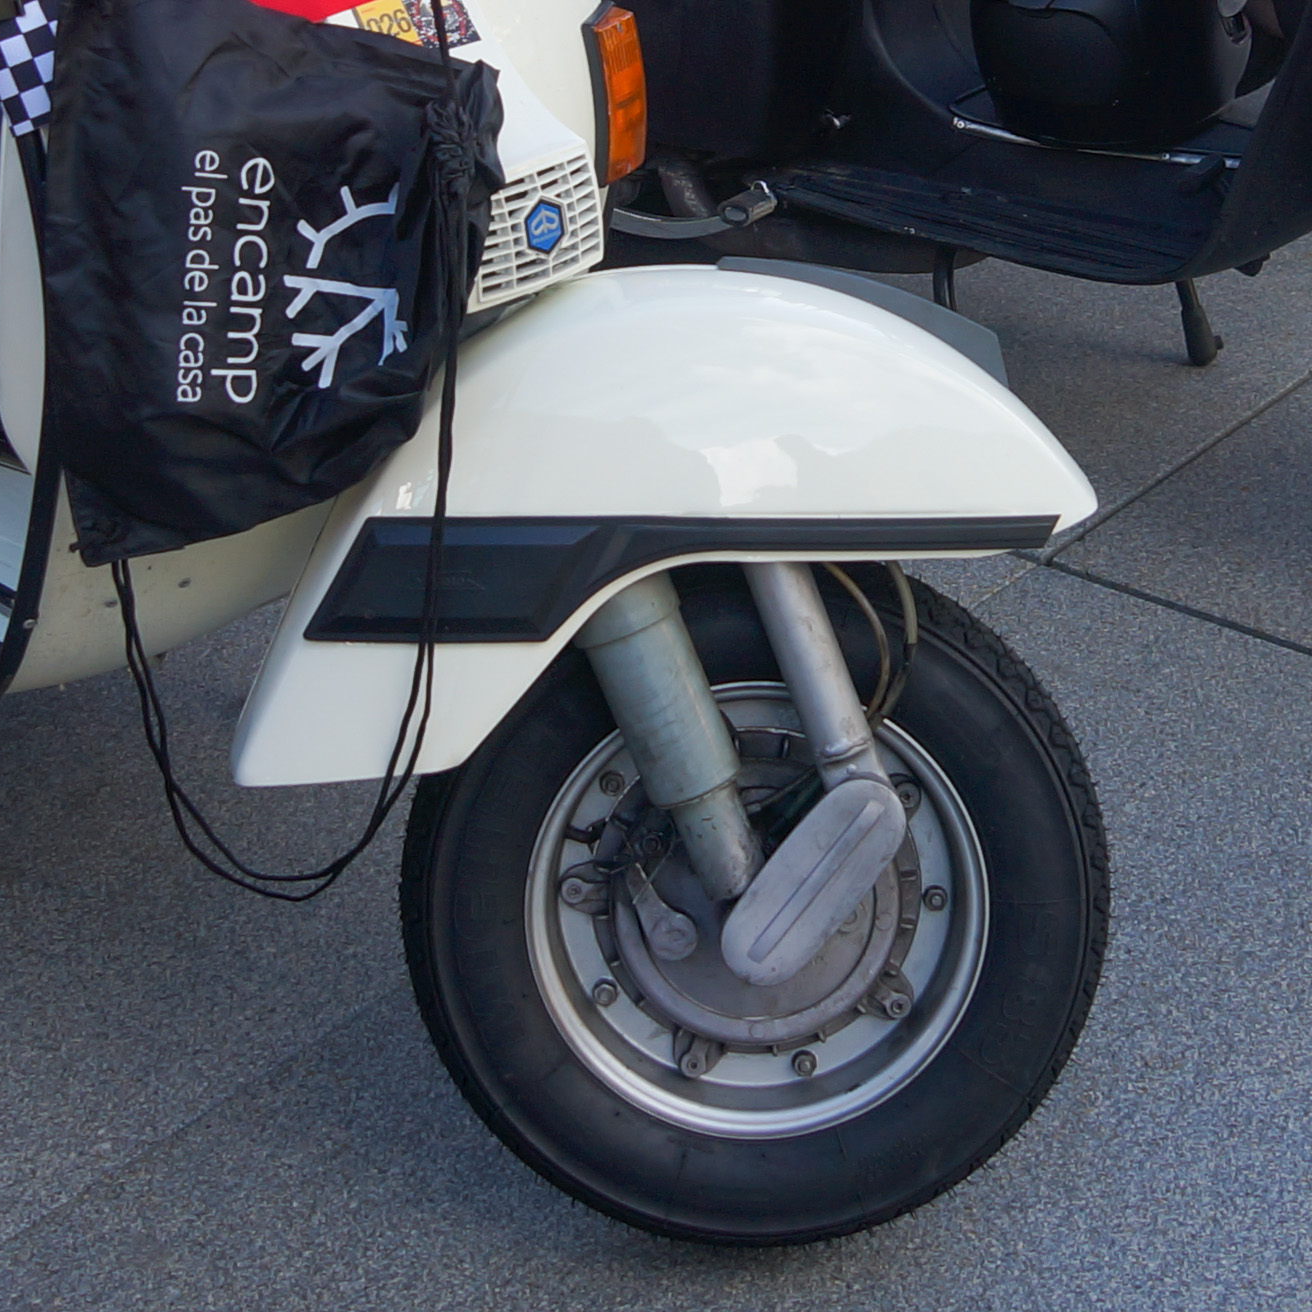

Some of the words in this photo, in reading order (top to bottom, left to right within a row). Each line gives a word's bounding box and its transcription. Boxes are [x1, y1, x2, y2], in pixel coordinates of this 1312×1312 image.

[194, 150, 228, 179] el
[181, 186, 216, 241] pas
[184, 249, 220, 292] de
[210, 157, 276, 404] encamp
[182, 301, 218, 325] la
[176, 332, 204, 403] casa
